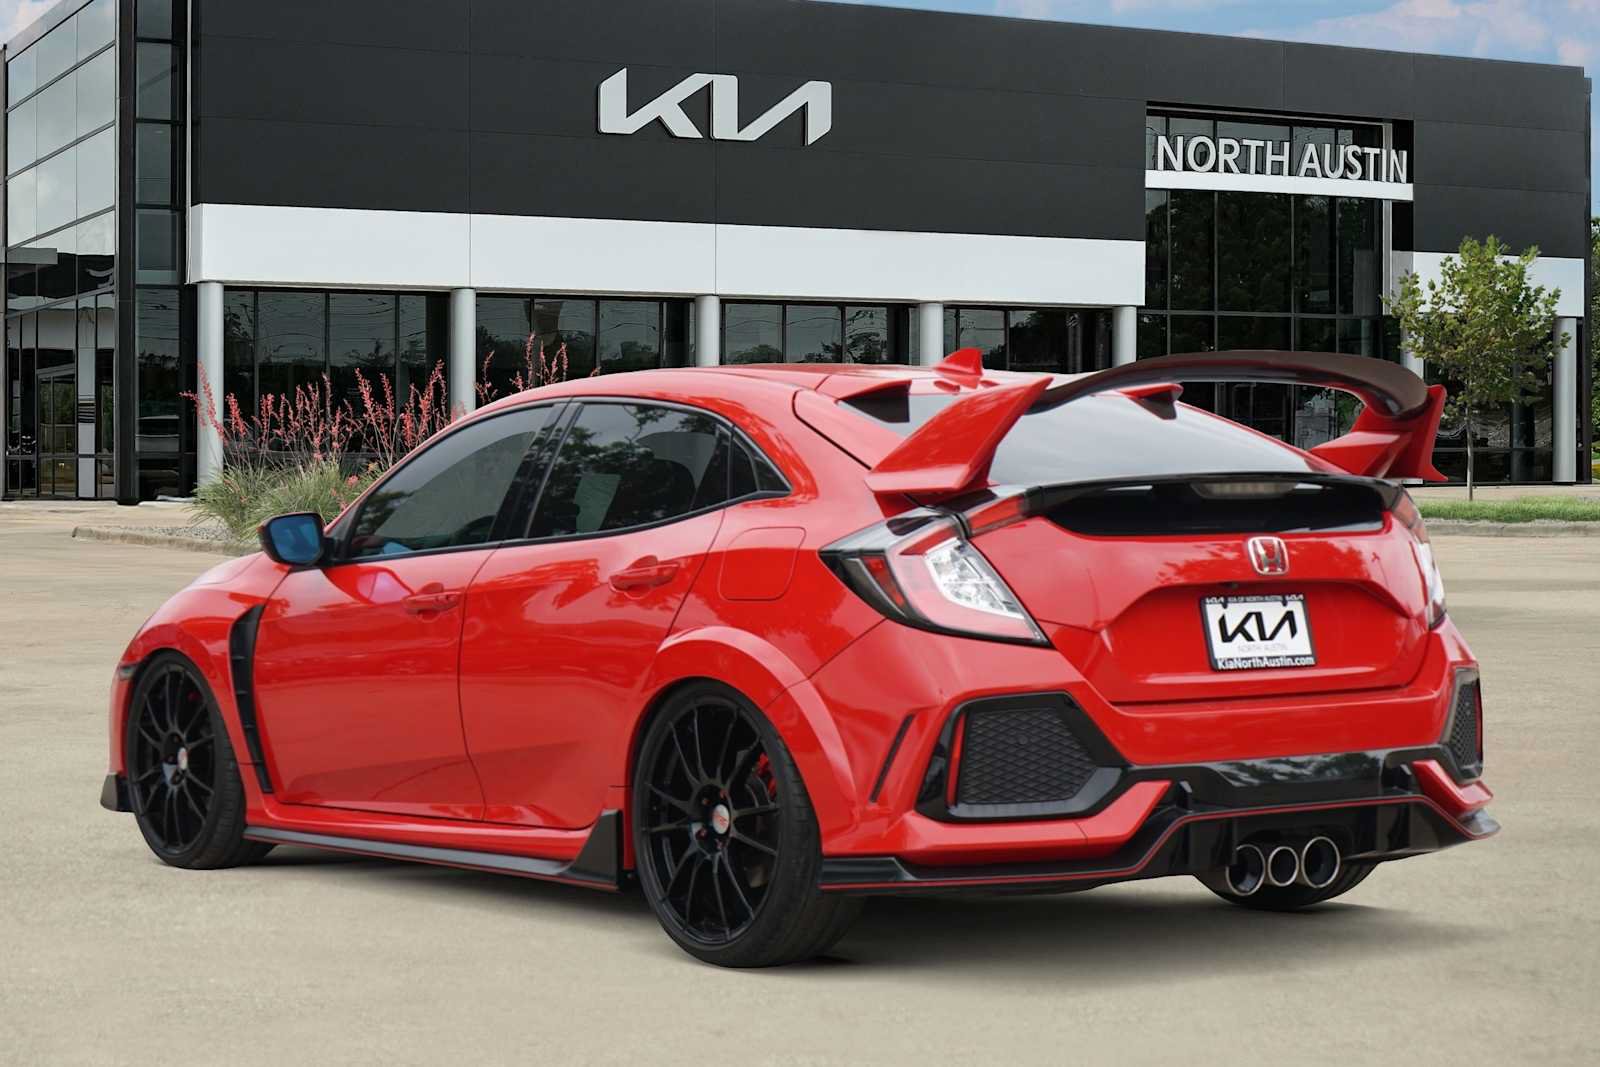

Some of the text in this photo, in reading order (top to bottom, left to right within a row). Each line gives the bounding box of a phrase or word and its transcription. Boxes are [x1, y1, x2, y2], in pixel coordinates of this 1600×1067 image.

[598, 67, 832, 146] KIA
[1157, 135, 1408, 184] NORTH AUSTIN
[1218, 610, 1297, 643] KIA
[1217, 656, 1315, 670] KiaNorthAustin.com
